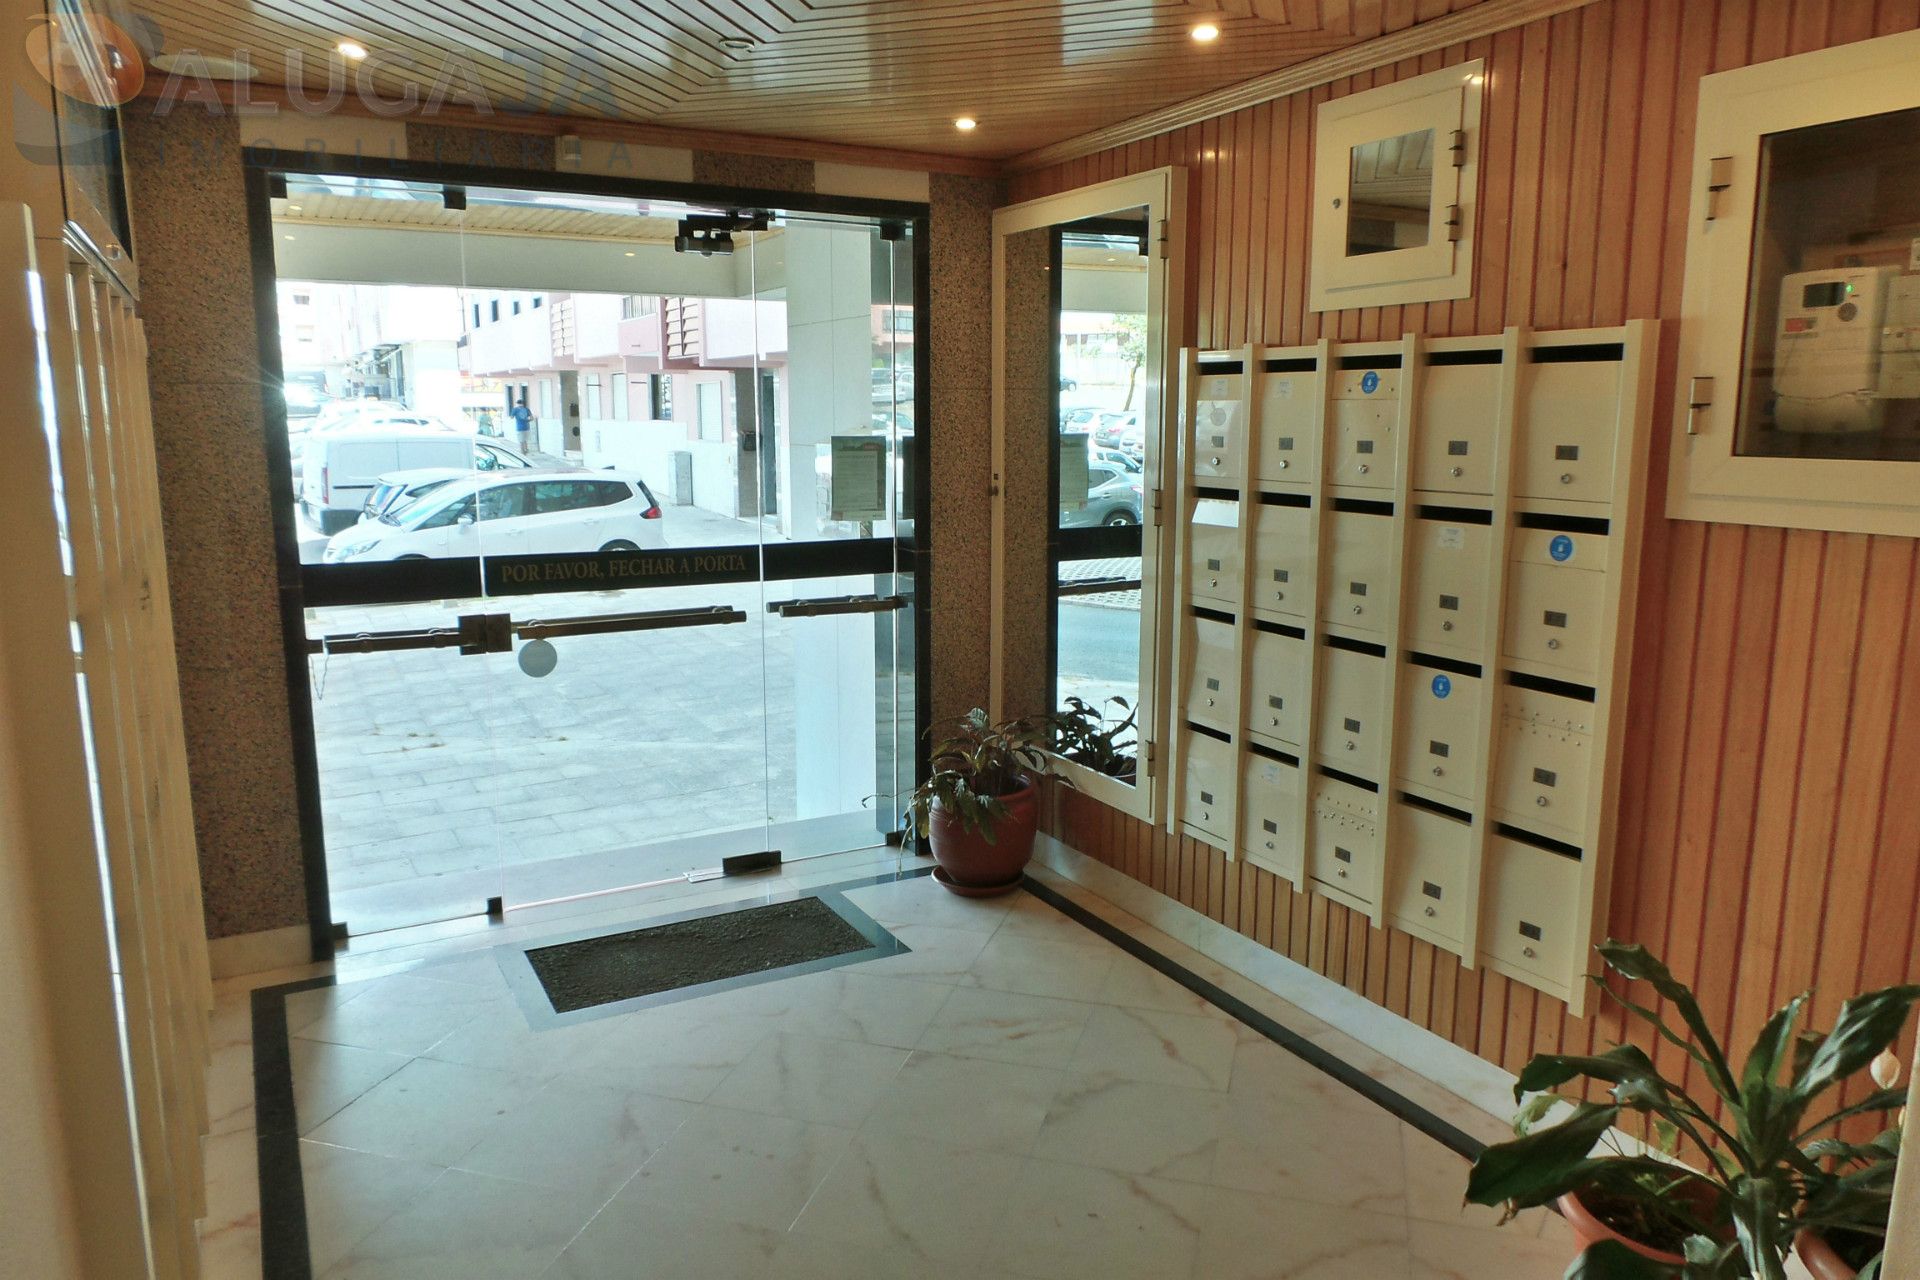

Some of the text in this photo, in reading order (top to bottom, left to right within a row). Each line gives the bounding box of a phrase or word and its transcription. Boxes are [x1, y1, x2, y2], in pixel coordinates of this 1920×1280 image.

[501, 564, 540, 582] POR
[544, 561, 604, 580] FAVOR,
[609, 558, 676, 577] FECHAR
[694, 555, 747, 574] PORTA
